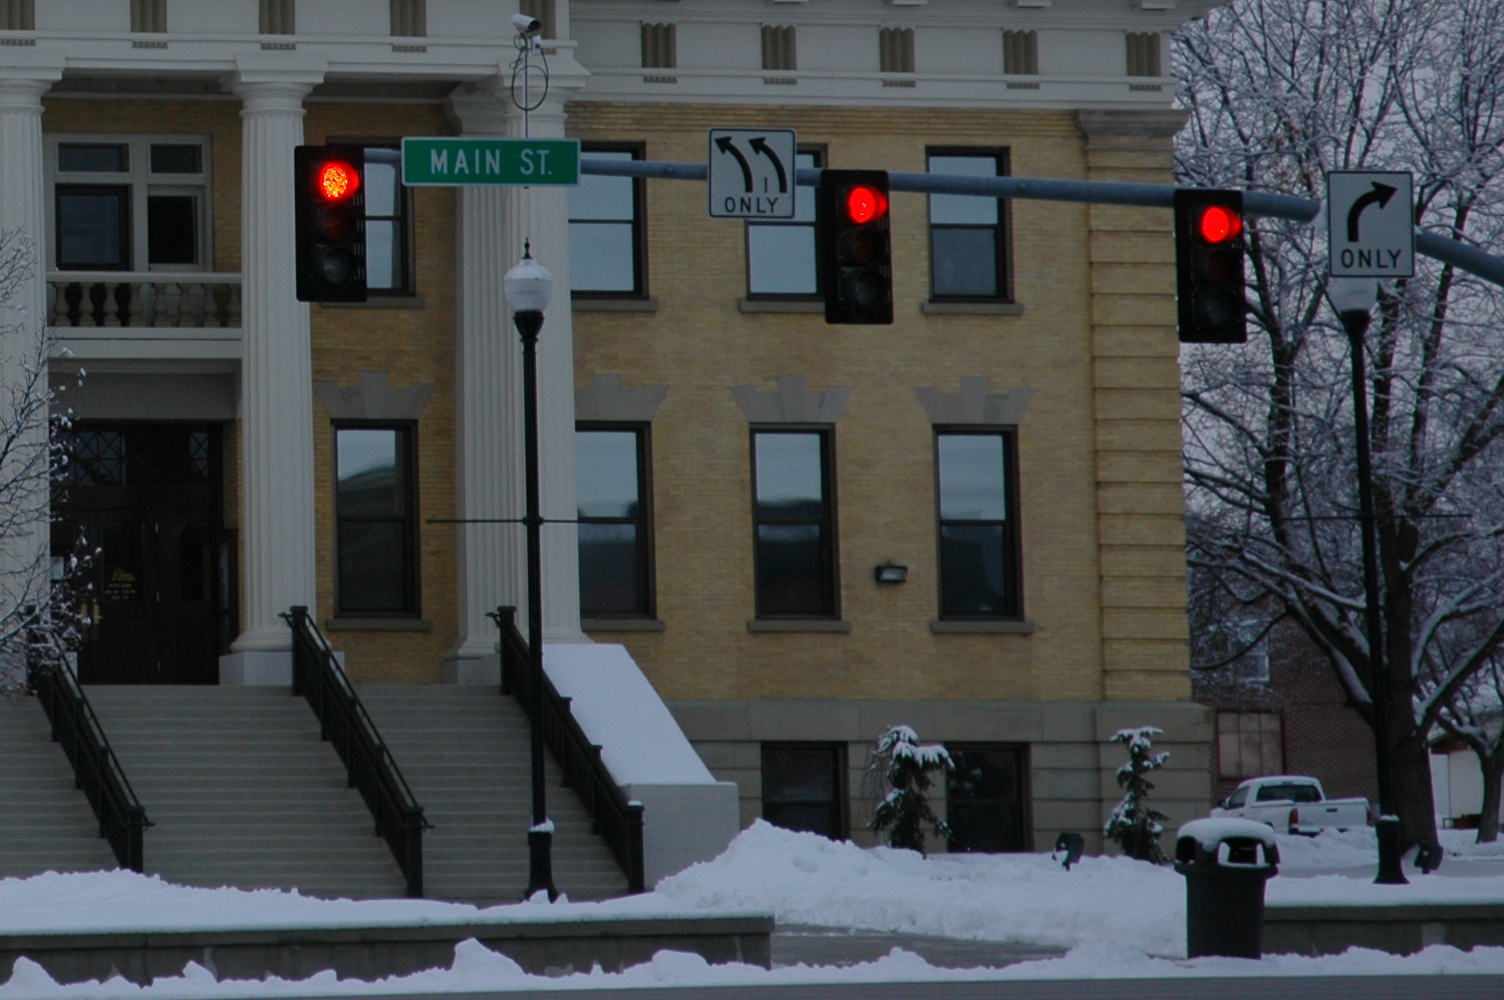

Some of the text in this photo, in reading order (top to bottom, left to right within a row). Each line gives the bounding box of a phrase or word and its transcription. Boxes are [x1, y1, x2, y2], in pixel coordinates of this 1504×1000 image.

[430, 148, 553, 176] MAIN ST.
[724, 196, 779, 214] ONLY
[1341, 248, 1402, 269] ONLY
